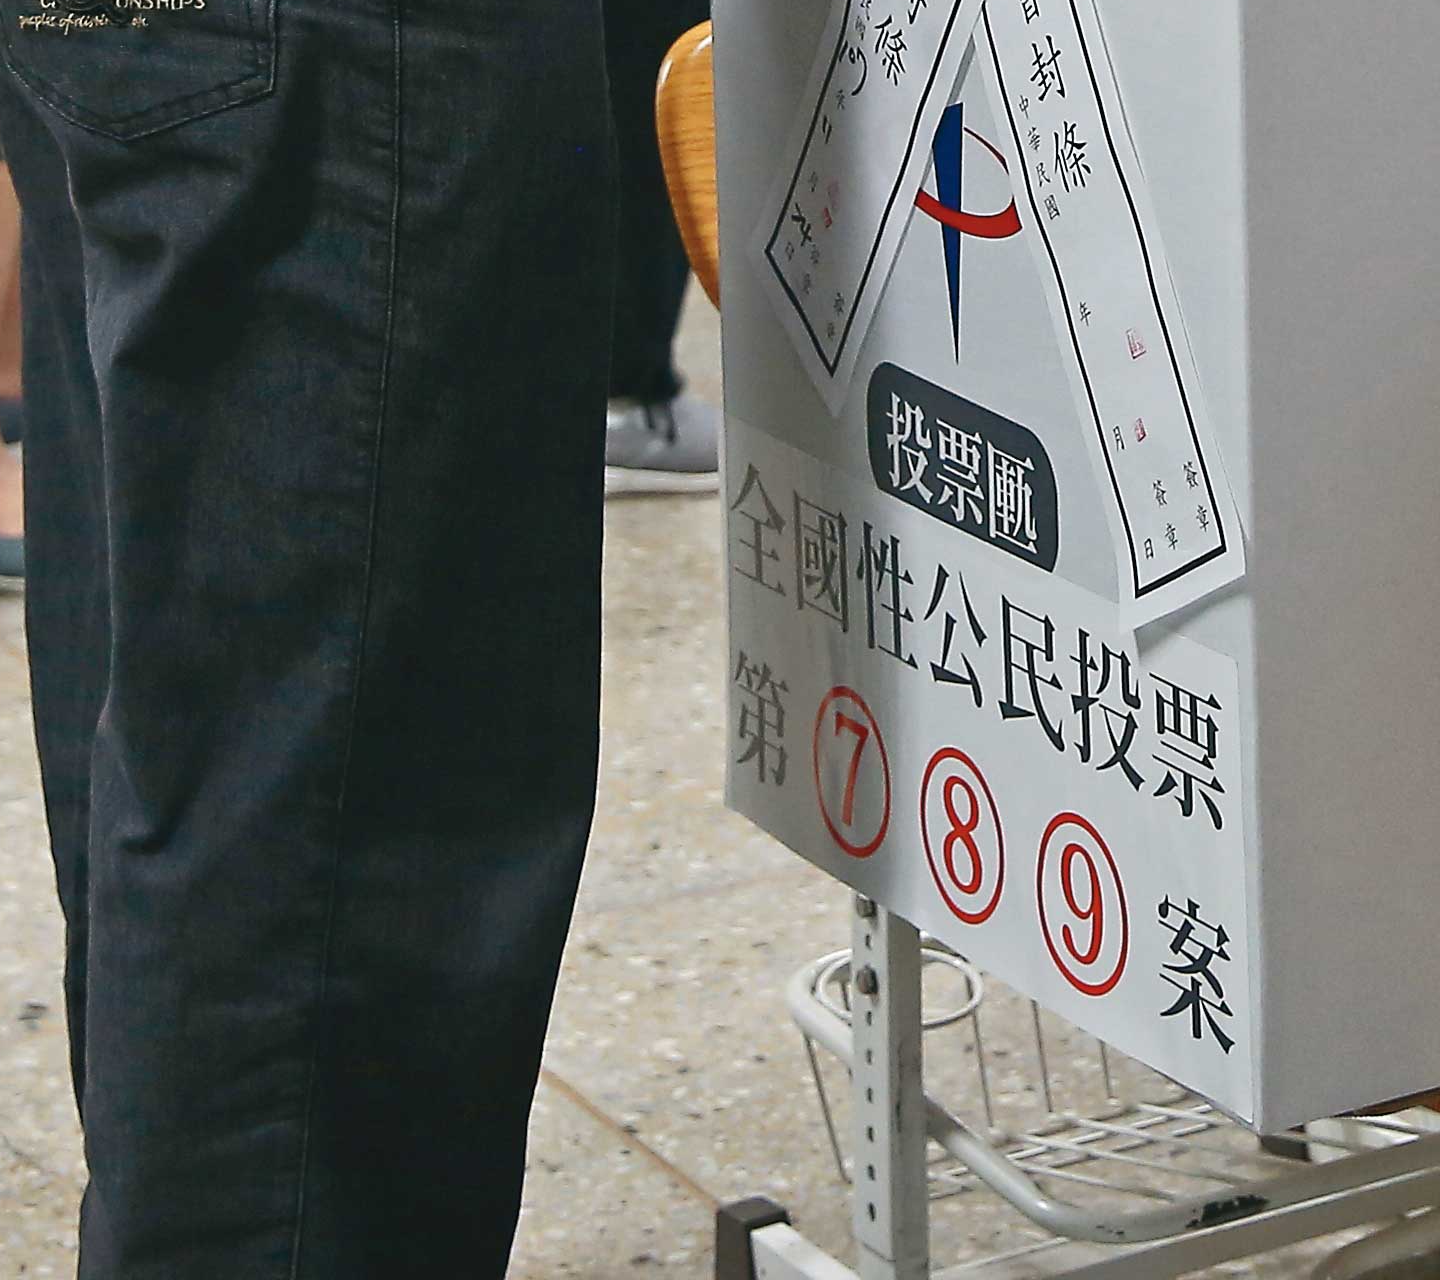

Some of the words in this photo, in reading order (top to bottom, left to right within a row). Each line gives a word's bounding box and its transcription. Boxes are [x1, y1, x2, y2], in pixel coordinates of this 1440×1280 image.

[1018, 94, 1061, 221] 中華民國
[730, 461, 1226, 833] 全國性公民投票
